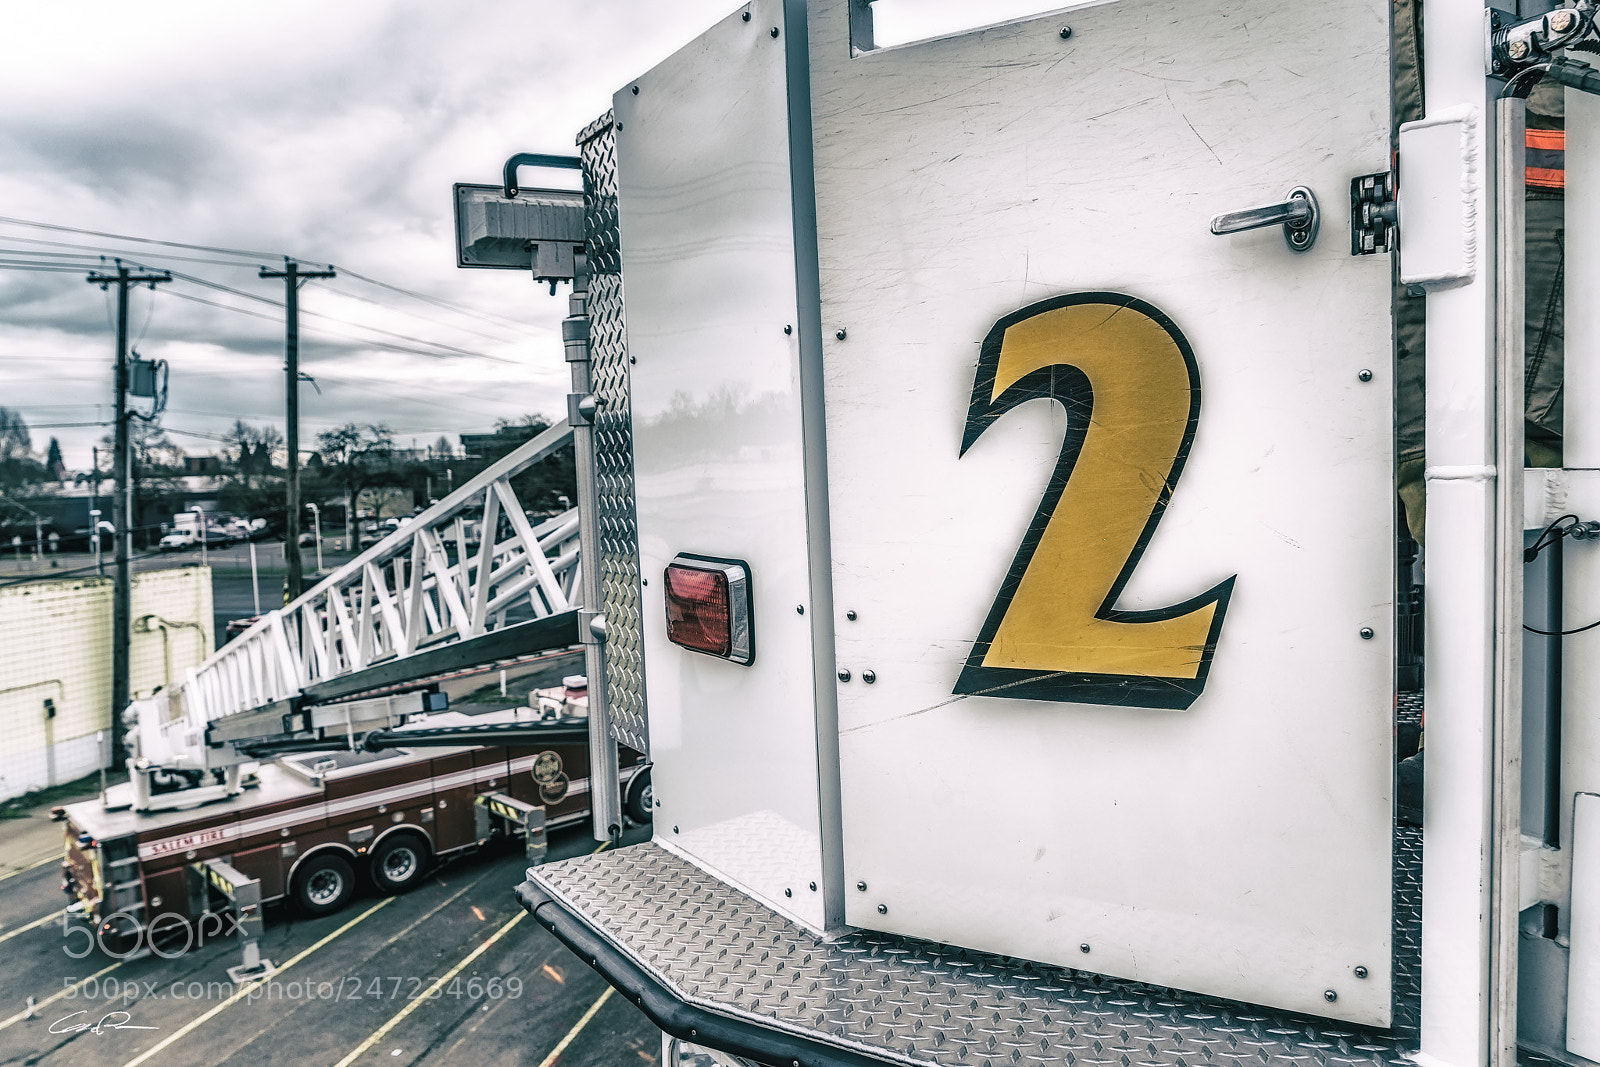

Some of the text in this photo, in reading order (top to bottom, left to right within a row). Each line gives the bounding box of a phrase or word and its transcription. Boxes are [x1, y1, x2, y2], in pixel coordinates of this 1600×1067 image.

[952, 291, 1237, 711] 2
[152, 829, 225, 855] SALEM FIRE
